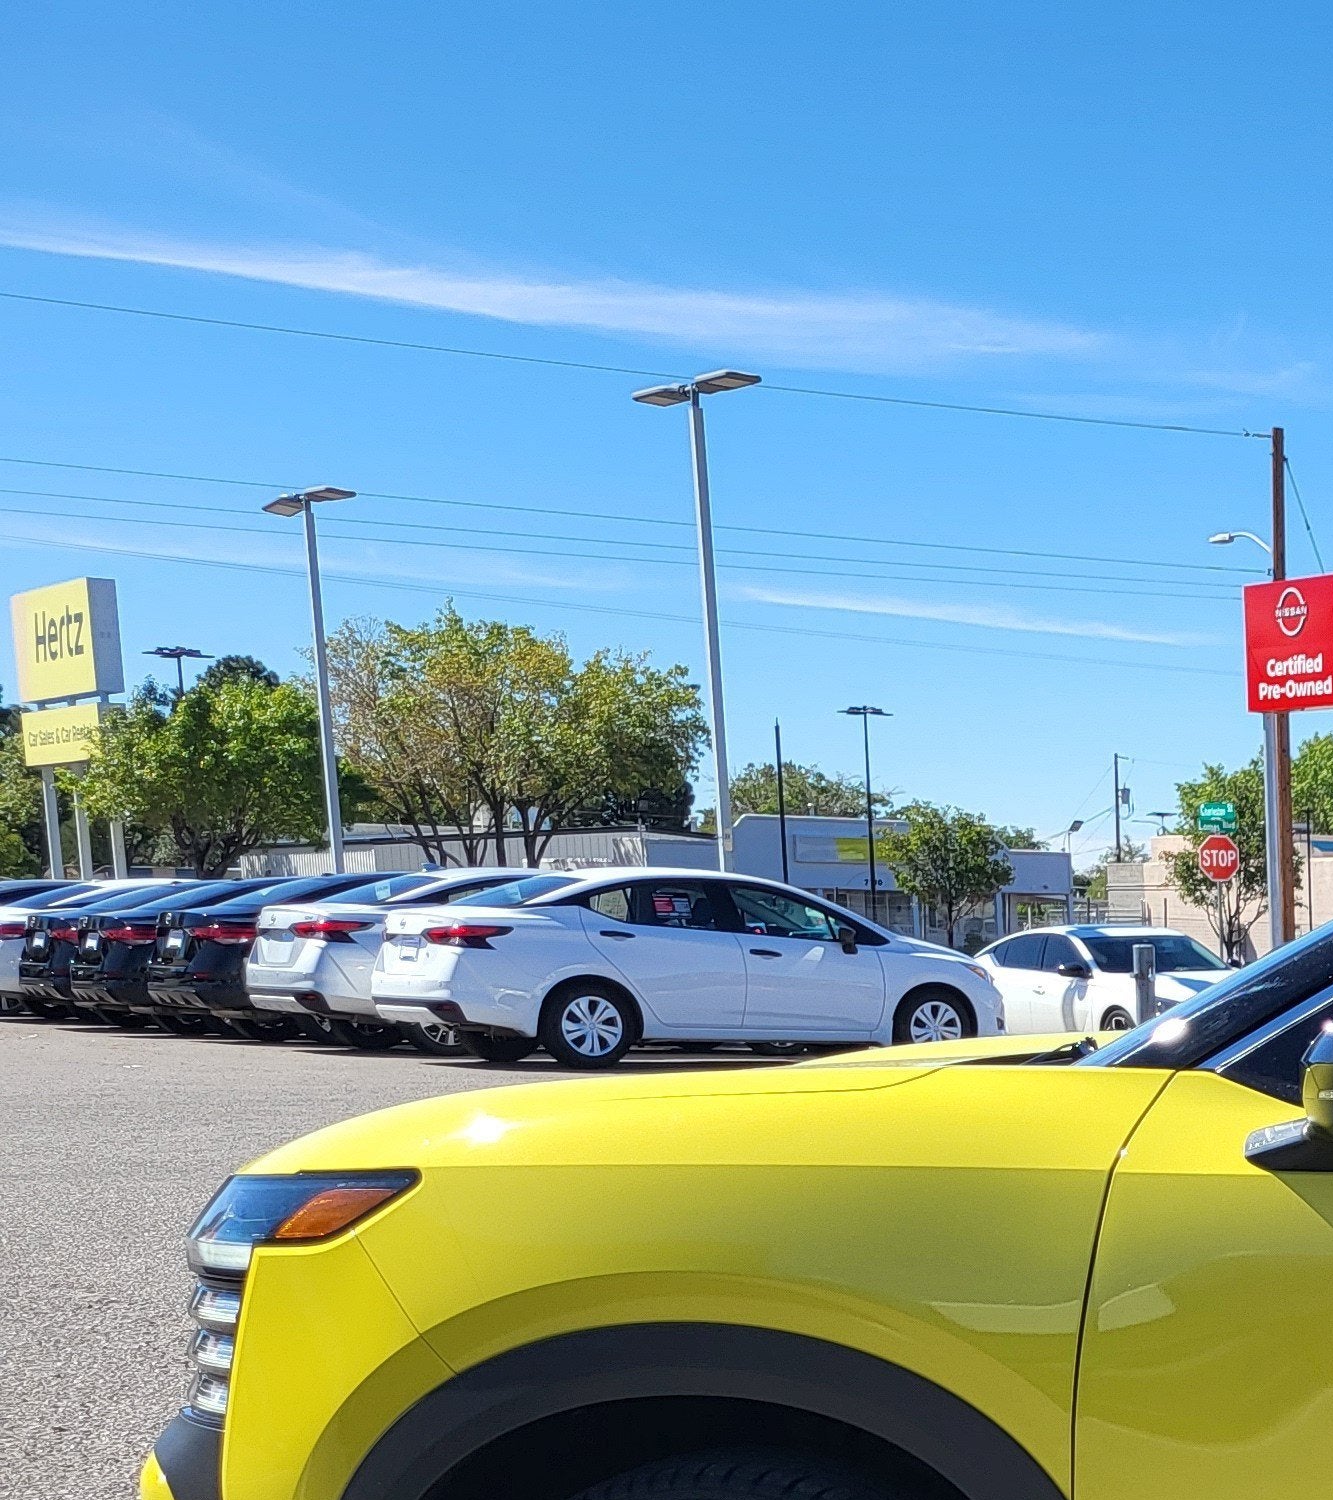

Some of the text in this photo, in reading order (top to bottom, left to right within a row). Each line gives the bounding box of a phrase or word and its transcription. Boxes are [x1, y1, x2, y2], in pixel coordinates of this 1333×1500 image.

[1275, 605, 1307, 618] NISSAN
[34, 605, 85, 663] Hertz
[1266, 653, 1323, 677] Certified
[1258, 675, 1333, 700] Pre-Owned
[28, 731, 38, 747] Car
[39, 729, 55, 746] Sales
[61, 726, 71, 743] Car
[1202, 849, 1236, 867] STOP
